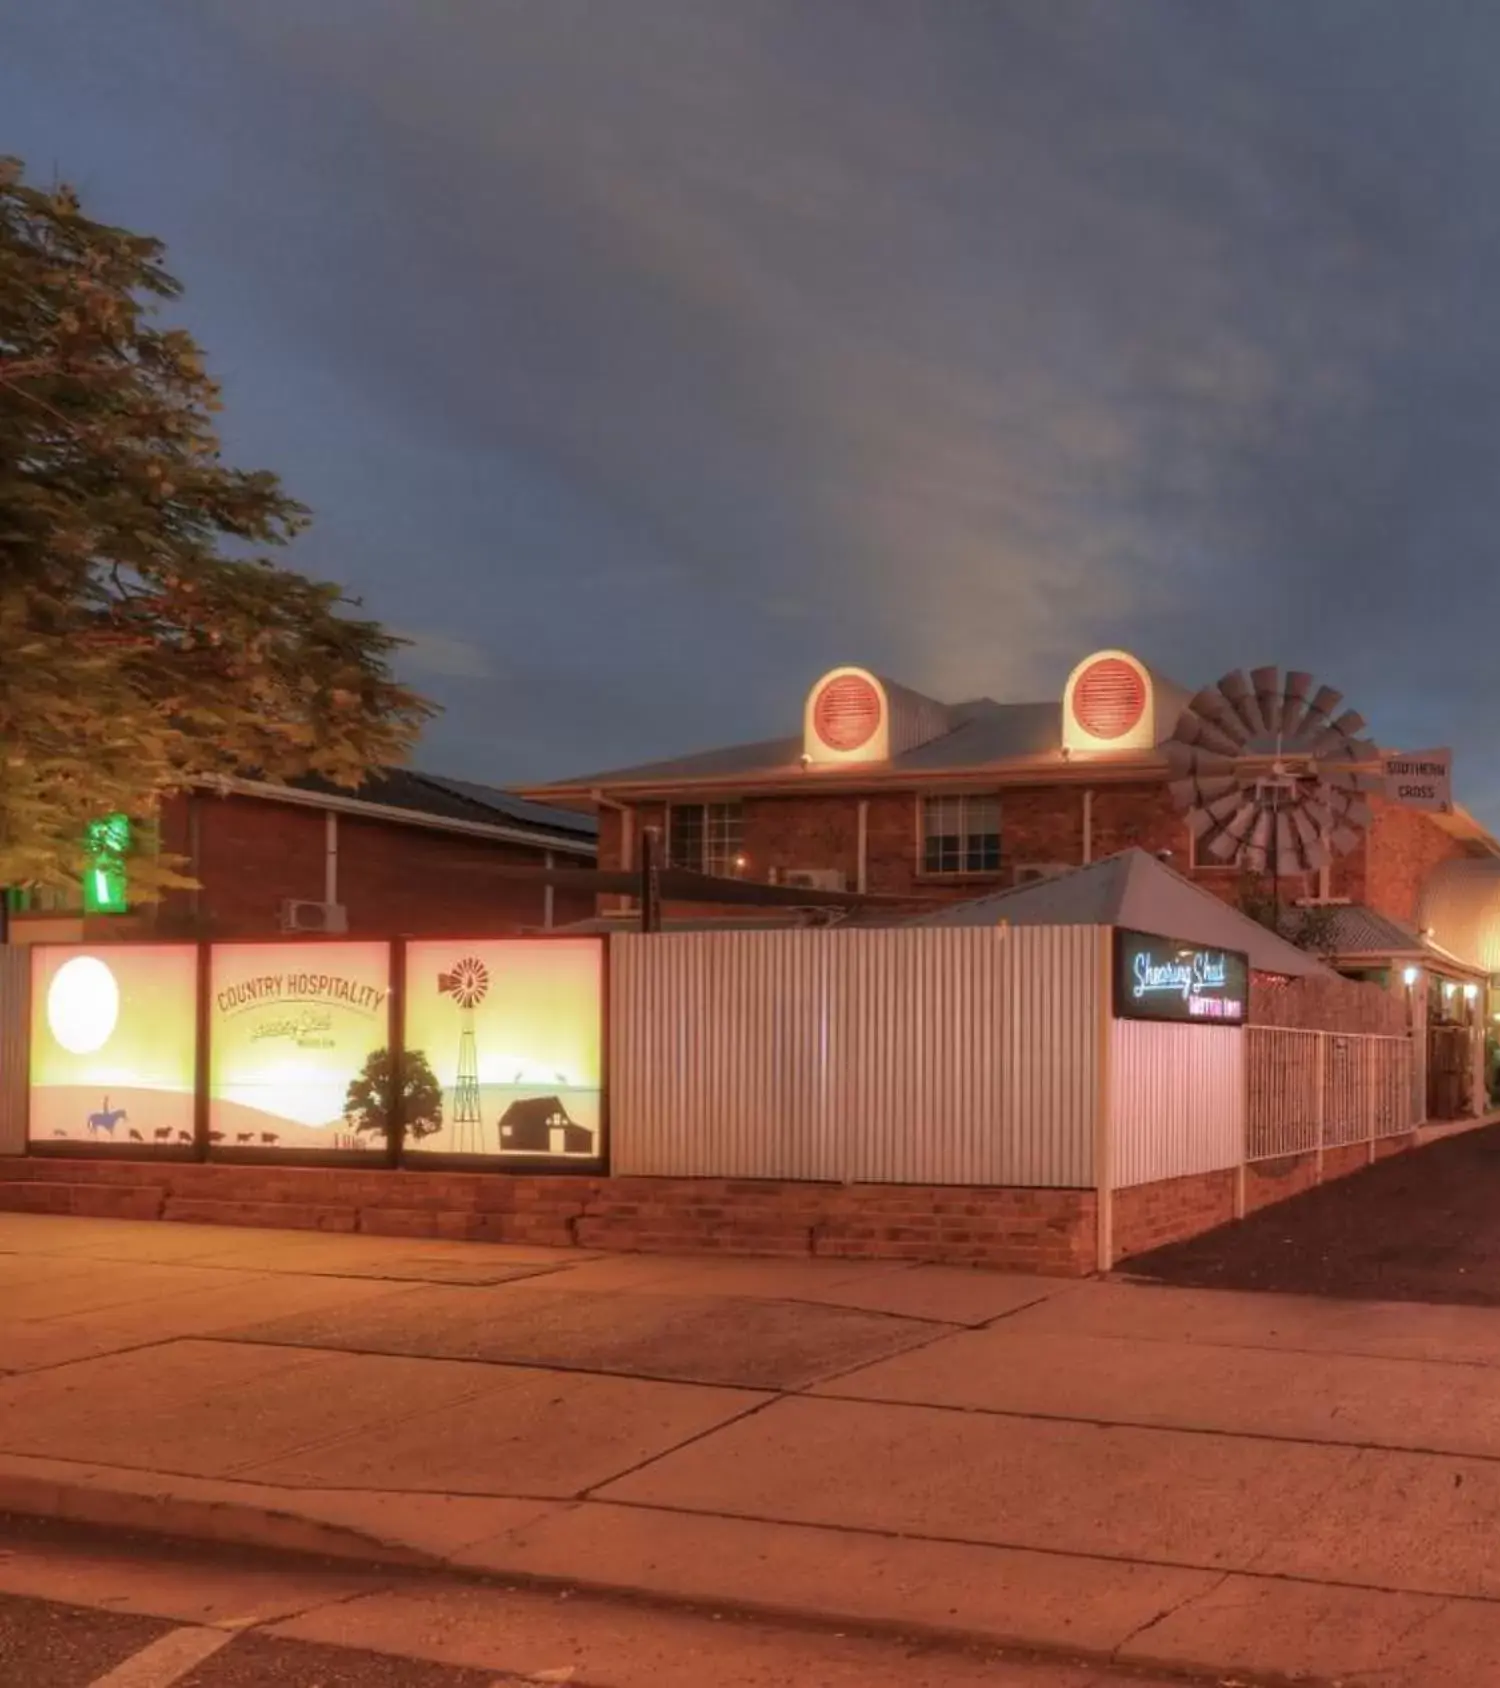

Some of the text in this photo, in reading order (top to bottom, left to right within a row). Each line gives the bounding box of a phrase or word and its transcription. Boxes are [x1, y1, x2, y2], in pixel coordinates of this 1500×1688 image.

[1398, 785, 1435, 798] CROSS
[217, 974, 386, 1012] COUNTRY HOSPITALITY
